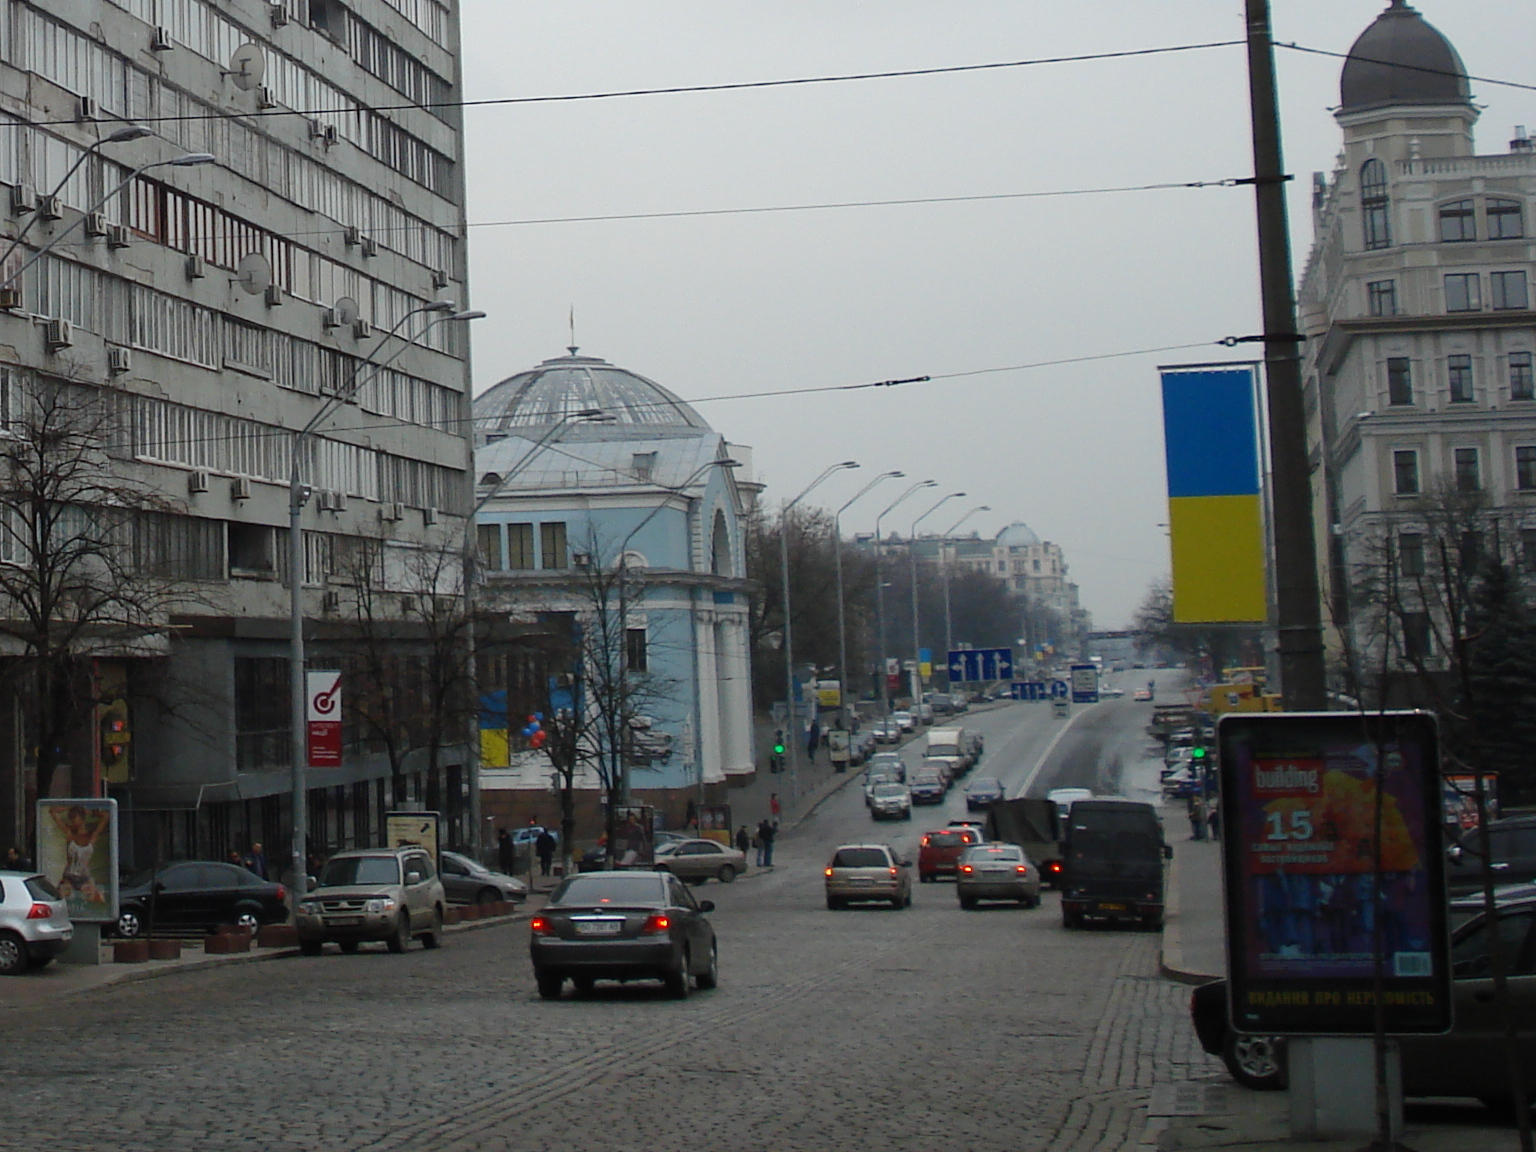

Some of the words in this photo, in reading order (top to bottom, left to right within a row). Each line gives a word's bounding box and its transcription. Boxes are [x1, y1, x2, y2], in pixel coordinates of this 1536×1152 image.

[1254, 764, 1319, 793] building
[1266, 810, 1314, 841] 15
[1315, 991, 1341, 1005] ПРО
